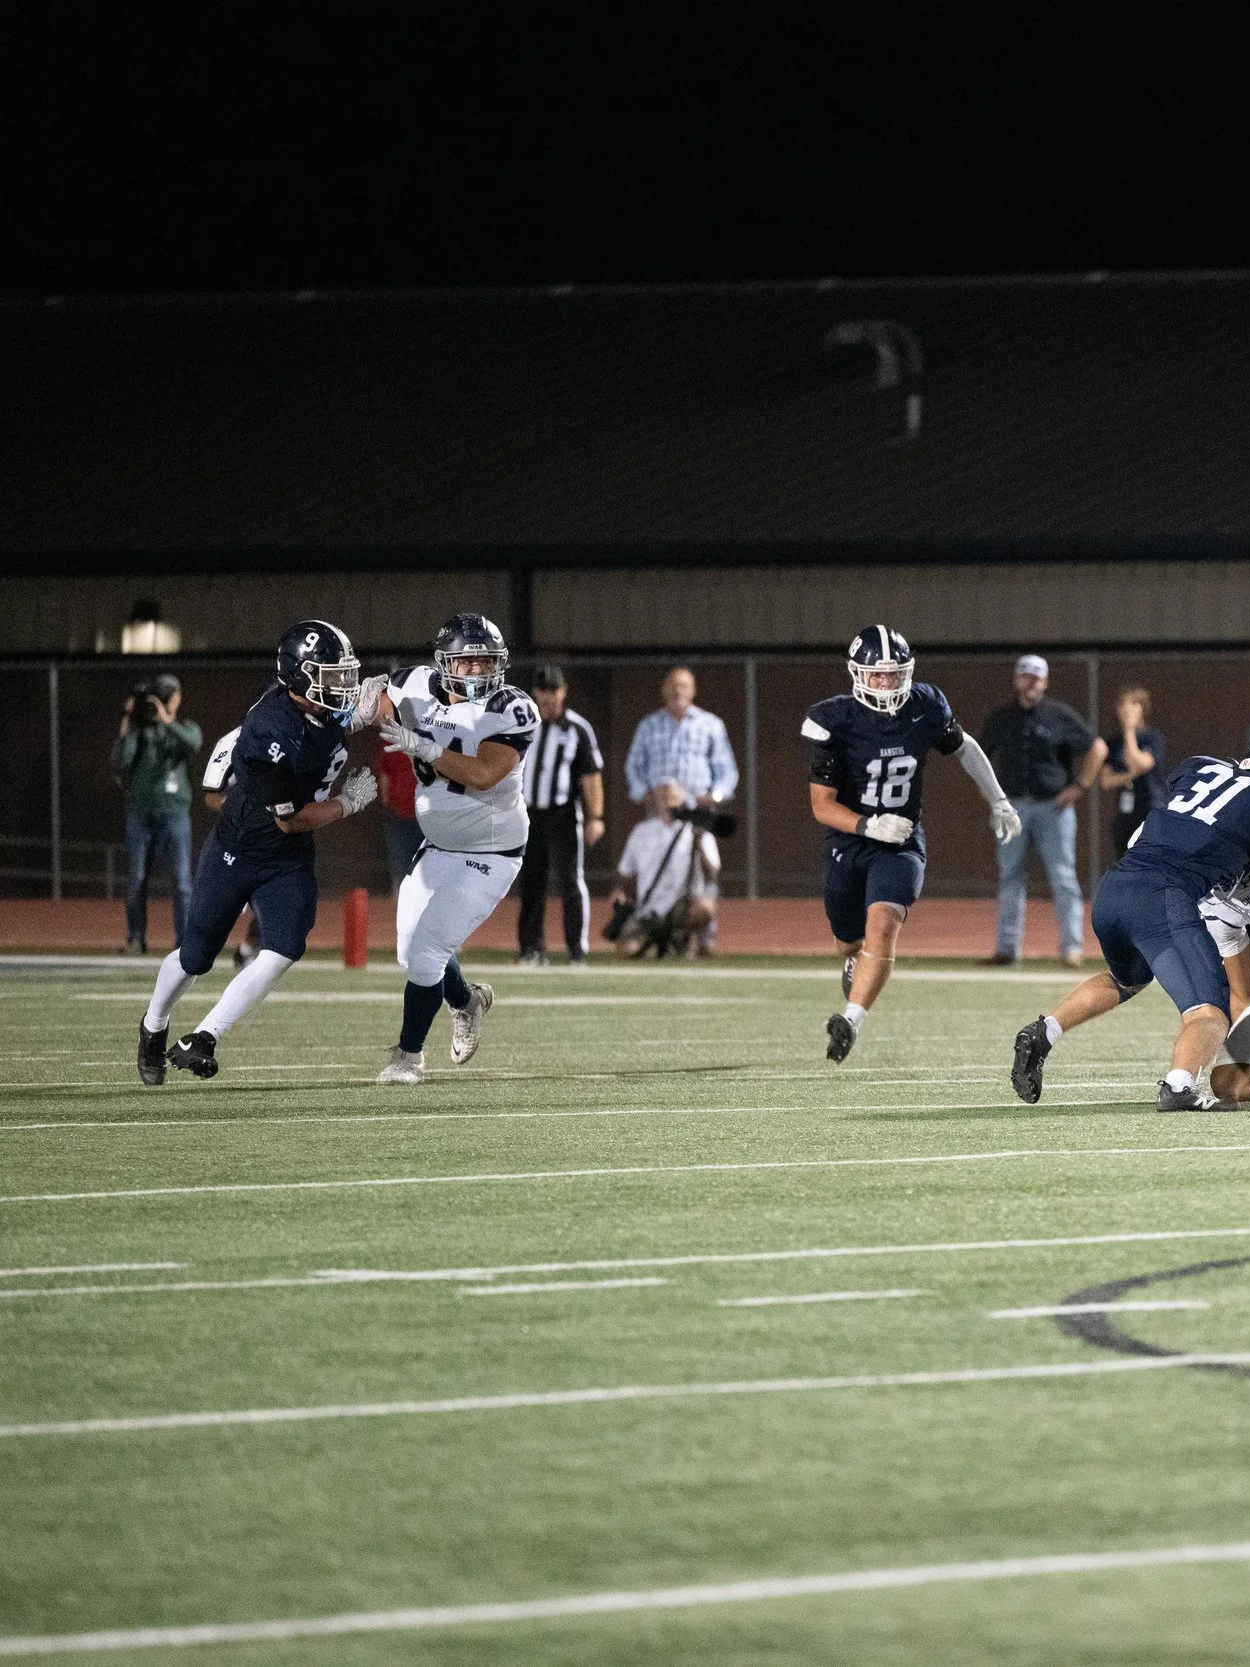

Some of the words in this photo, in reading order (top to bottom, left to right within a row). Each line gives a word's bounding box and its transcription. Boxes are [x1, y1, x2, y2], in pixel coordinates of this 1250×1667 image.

[305, 632, 320, 652] 9
[420, 716, 457, 731] CHAMPION
[513, 703, 537, 727] 64
[268, 742, 285, 764] SV
[314, 747, 348, 803] 9
[860, 755, 918, 808] 18
[223, 851, 236, 866] SV
